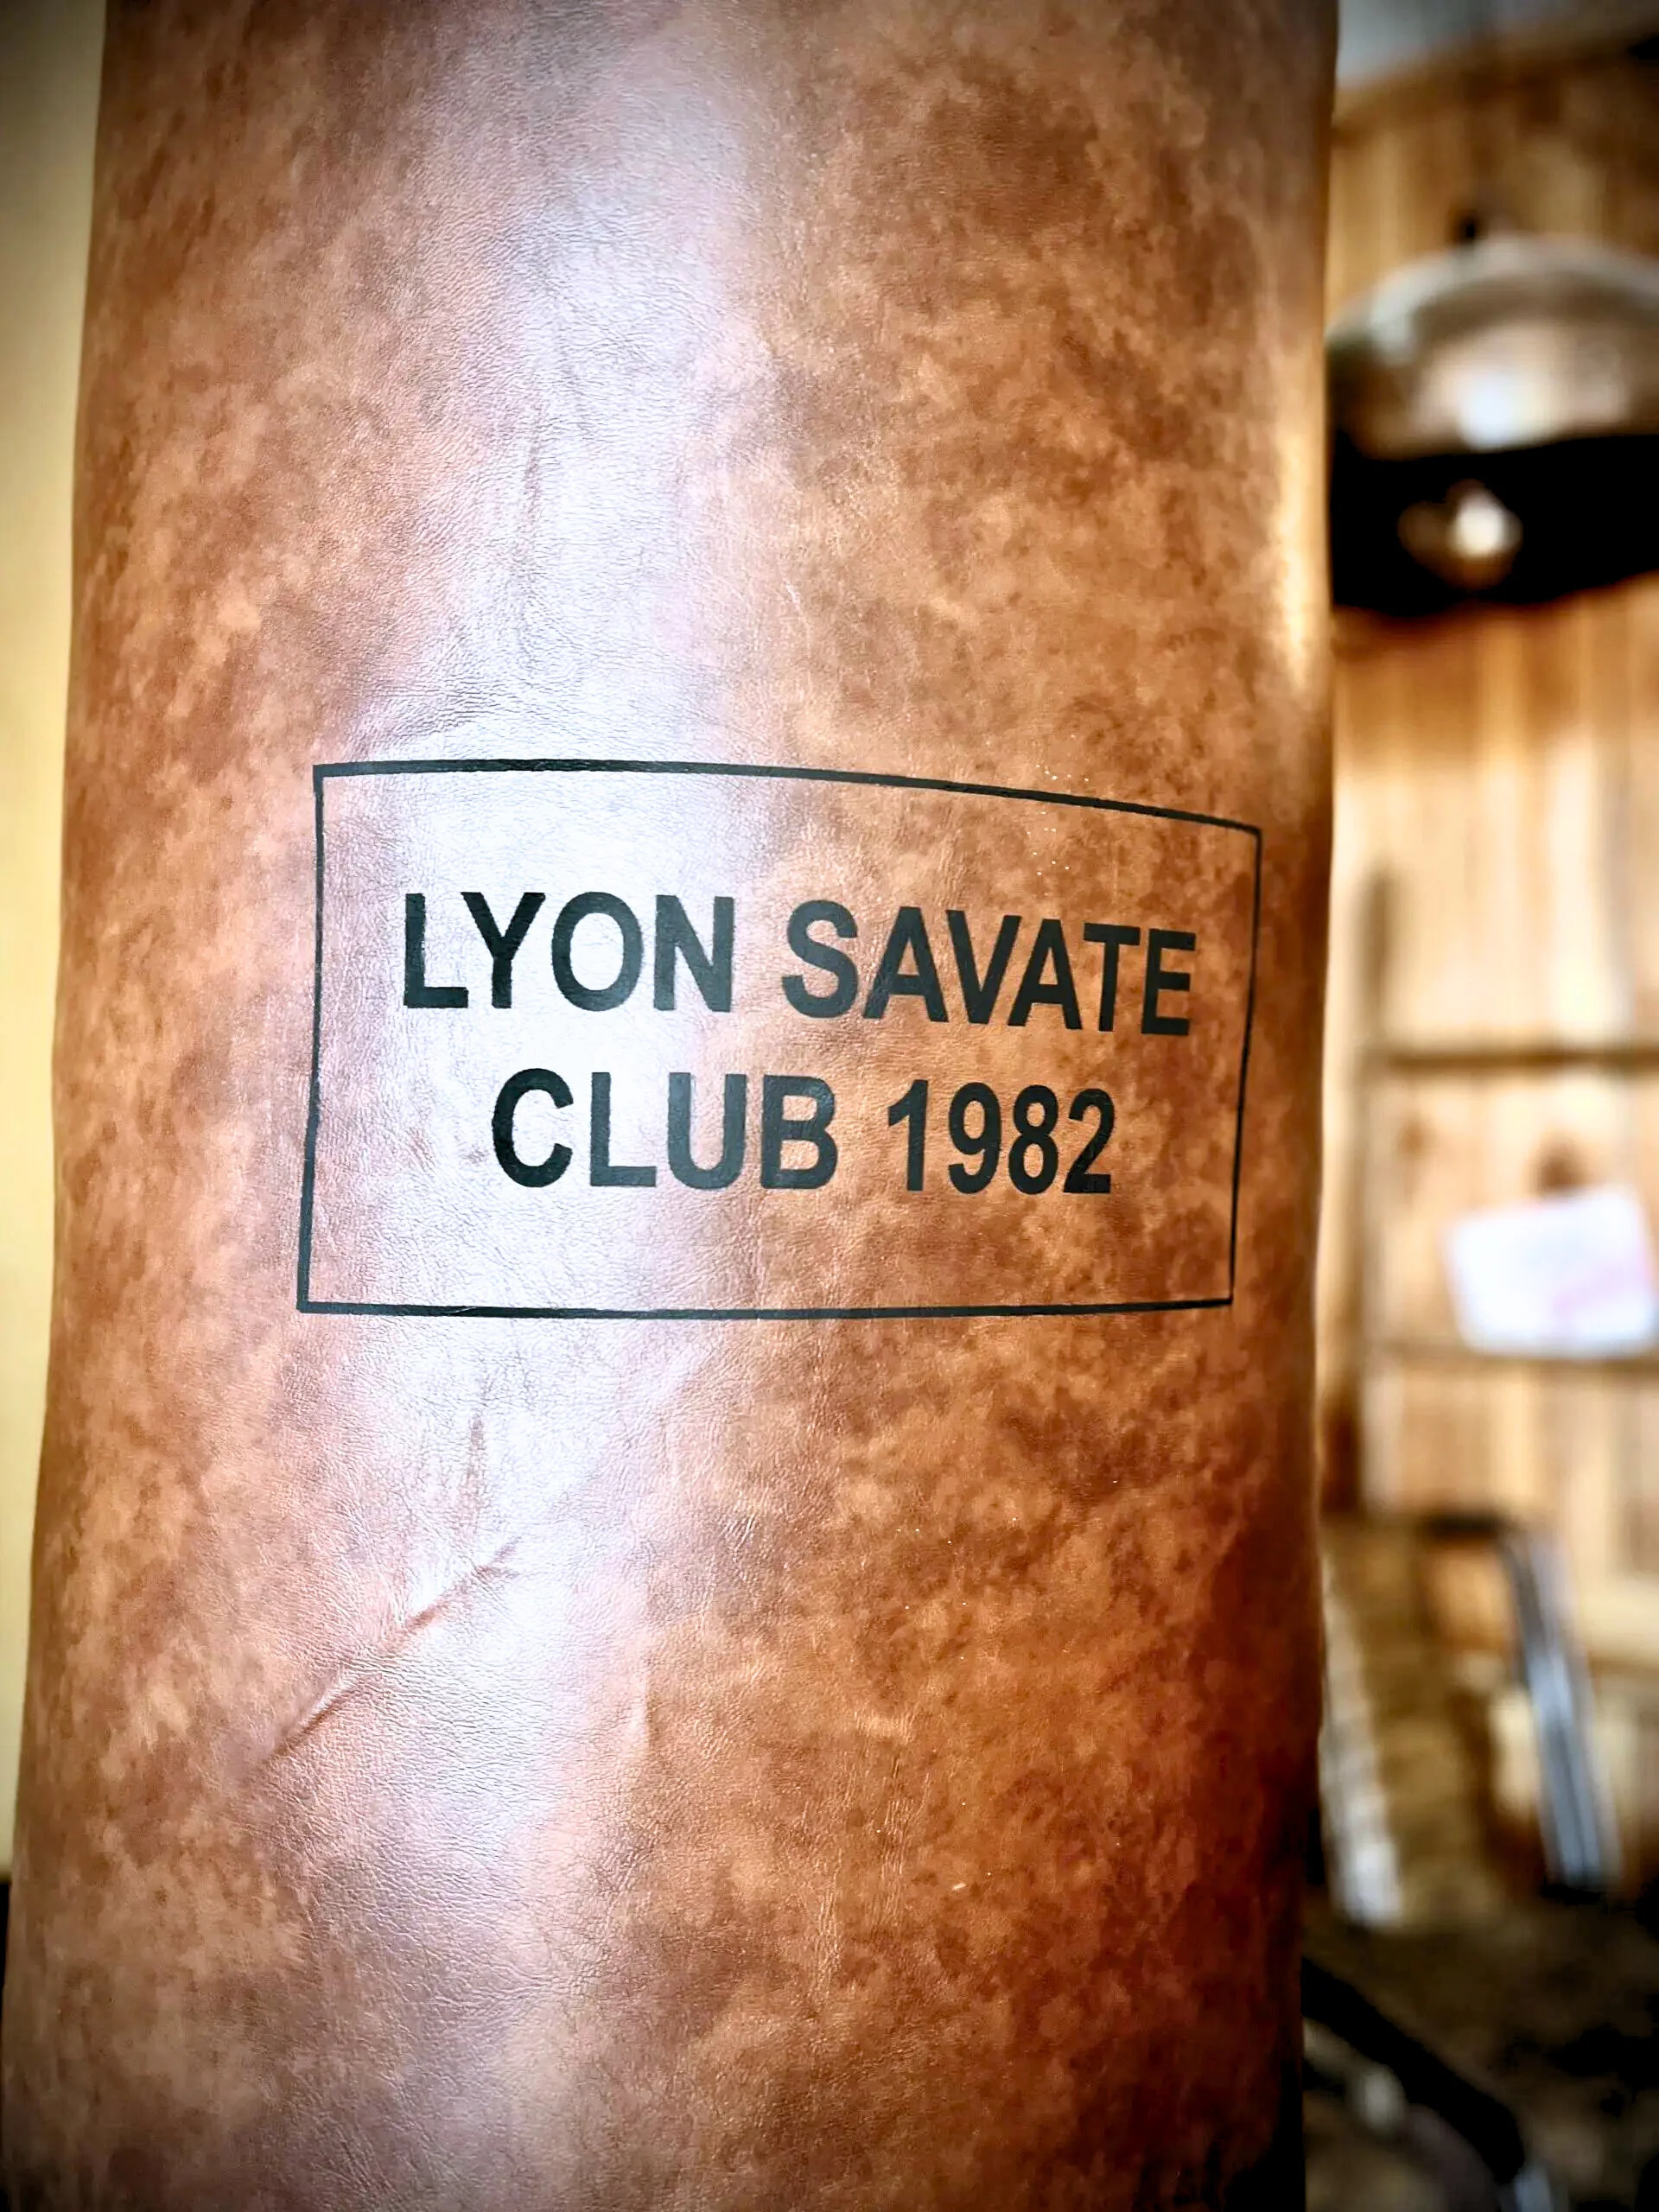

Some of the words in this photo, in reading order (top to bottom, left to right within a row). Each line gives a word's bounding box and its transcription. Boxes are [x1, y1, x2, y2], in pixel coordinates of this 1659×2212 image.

[403, 891, 735, 1012] LYON
[781, 899, 1197, 1036] SAVATE
[492, 1068, 839, 1190] CLUB
[887, 1079, 1116, 1195] 1982
